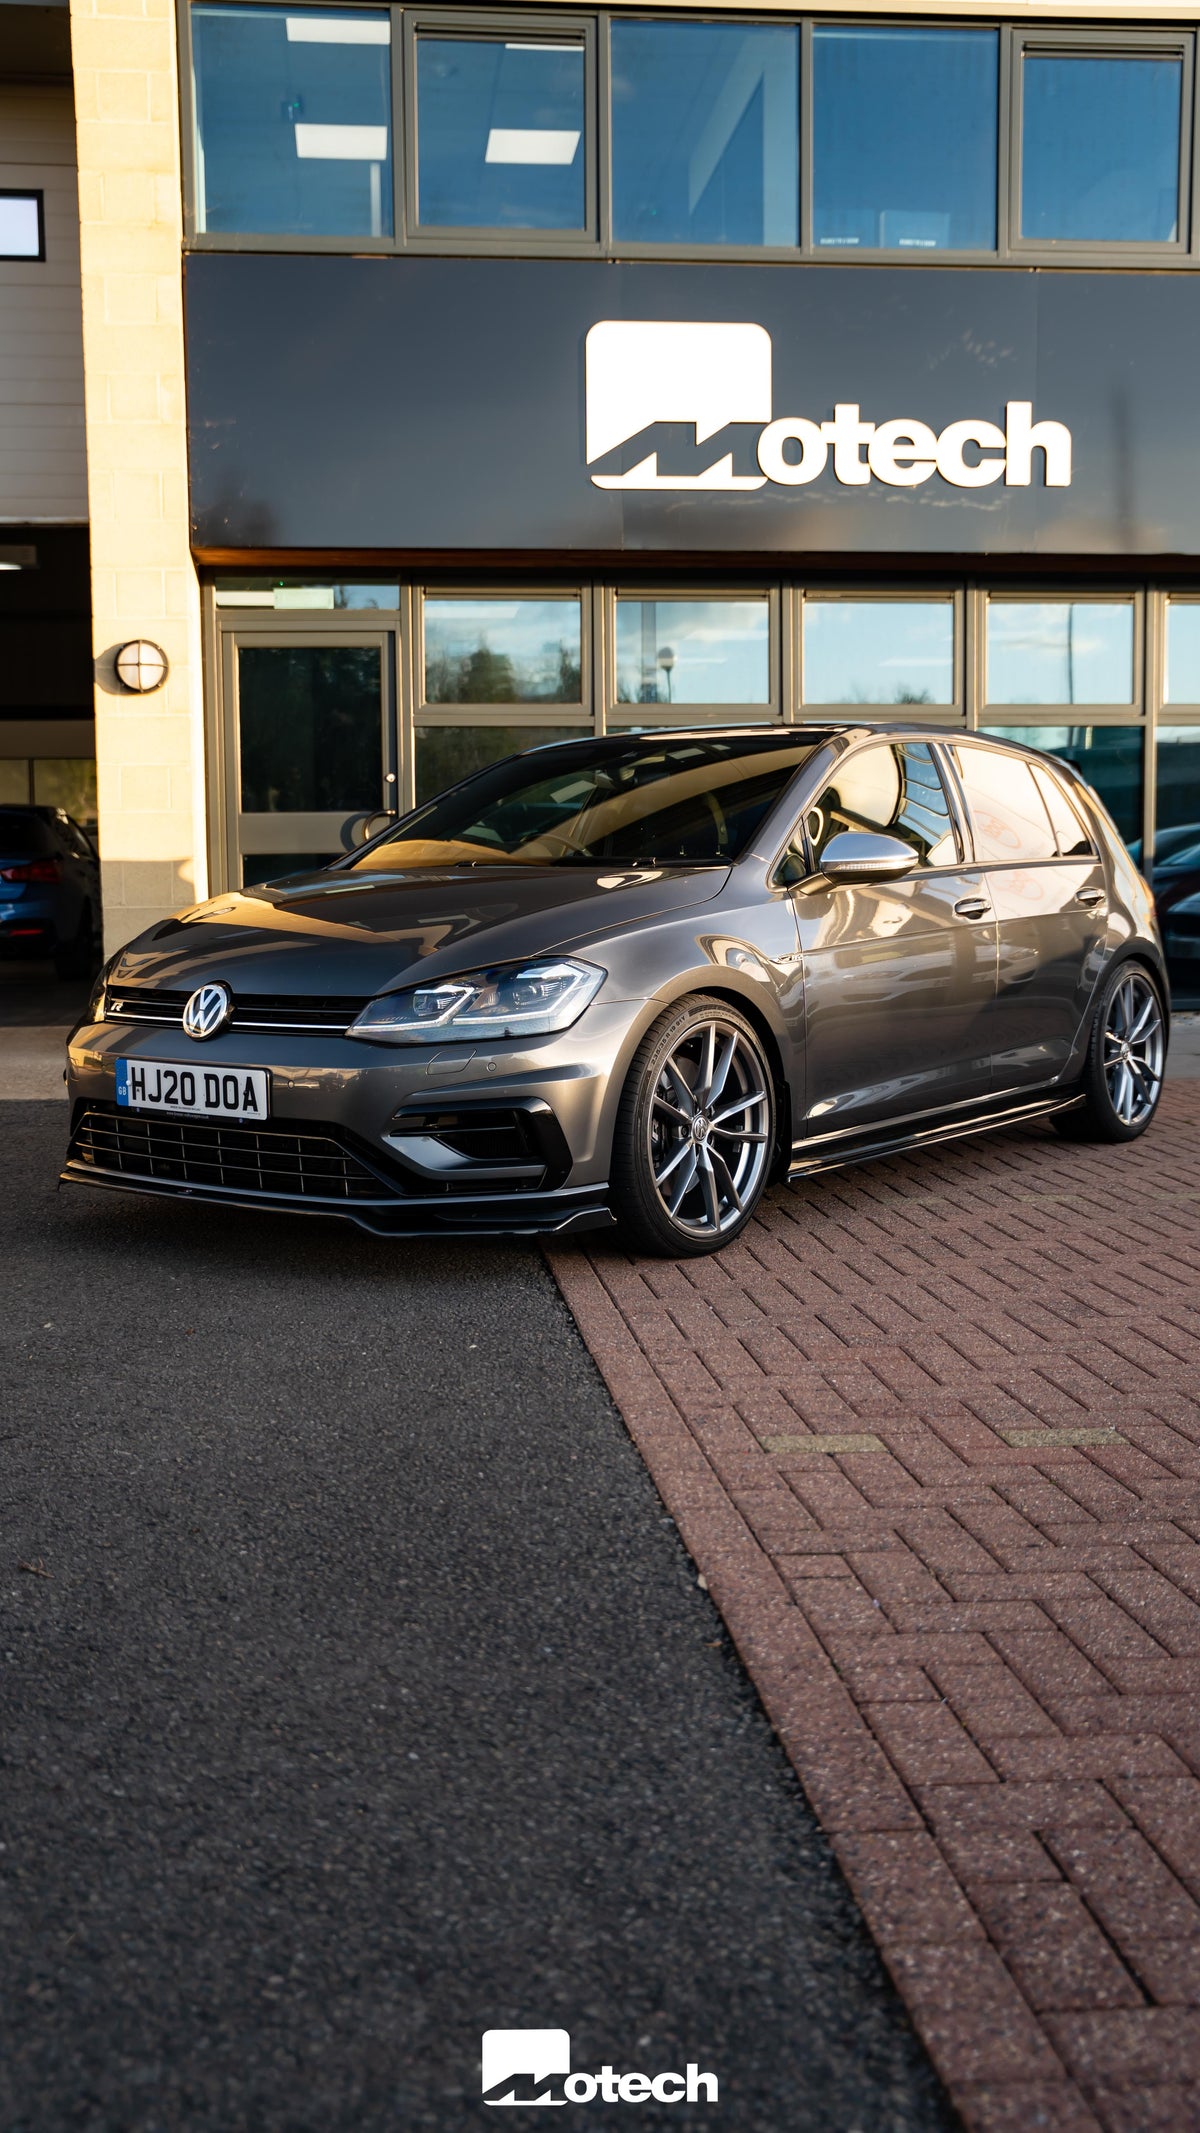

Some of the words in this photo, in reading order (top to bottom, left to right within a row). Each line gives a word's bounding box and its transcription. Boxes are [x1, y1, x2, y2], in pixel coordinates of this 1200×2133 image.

[585, 398, 1072, 490] Motech
[118, 1086, 127, 1096] GB
[131, 1067, 196, 1106] HJ20
[203, 1073, 259, 1112] DOA
